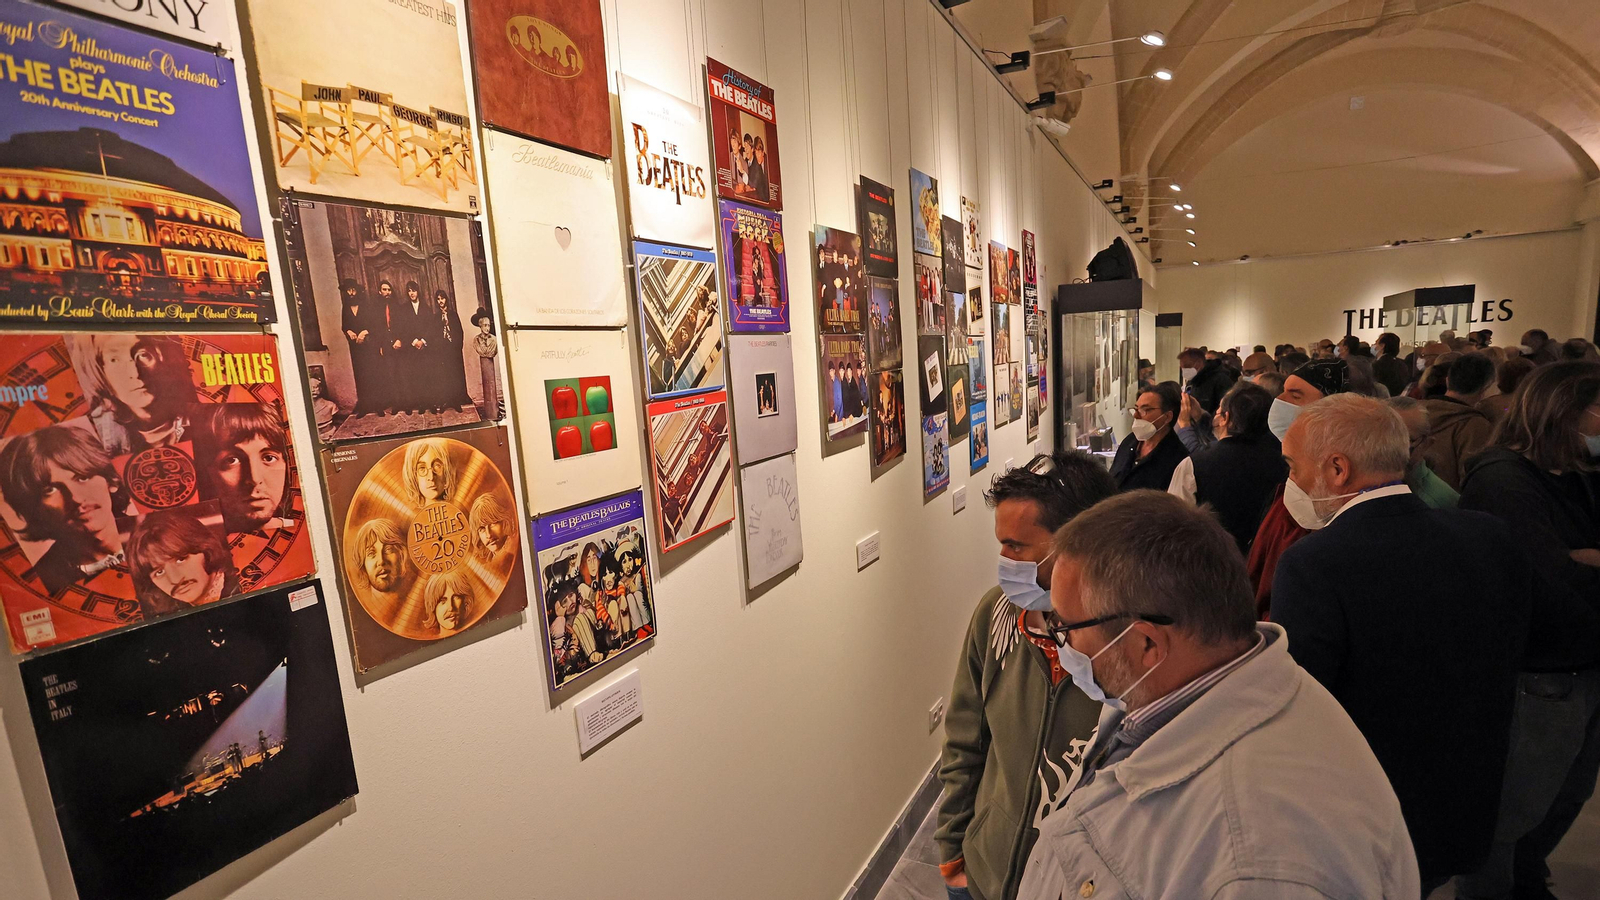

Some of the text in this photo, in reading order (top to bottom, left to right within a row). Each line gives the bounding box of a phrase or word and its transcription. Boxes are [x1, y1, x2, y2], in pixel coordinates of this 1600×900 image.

[38, 20, 152, 72] Philharmonic
[149, 49, 219, 88] Orchestra
[69, 57, 106, 74] plays
[0, 52, 176, 115] THE BEATLES
[313, 87, 342, 102] JOHN
[722, 69, 762, 99] History of
[20, 90, 159, 128] 20th Anniversary Concert
[358, 89, 383, 105] PAUL
[711, 79, 773, 121] THE BEATLES
[392, 104, 433, 129] GEORGE
[437, 109, 464, 126] RINGO
[662, 140, 678, 157] THE
[511, 144, 594, 180] Beatlemania
[631, 122, 706, 206] BEATLES
[37, 304, 49, 321] by
[49, 296, 94, 318] Louis
[92, 297, 135, 320] Clark
[136, 307, 153, 318] with
[154, 307, 166, 318] the
[164, 303, 197, 322] Royal
[197, 303, 228, 320] Choral
[228, 304, 257, 322] Society
[1343, 308, 1388, 337] THE
[540, 350, 566, 360] ARTFULLY
[200, 352, 275, 387] BEATLES
[426, 504, 448, 522] THE
[550, 500, 631, 533] THE BEATLES BALLADS
[414, 512, 465, 542] BEATLES
[431, 539, 455, 561] 20
[445, 556, 458, 571] DE
[457, 534, 468, 558] ORO
[26, 612, 46, 622] EMI
[42, 674, 58, 686] THE
[45, 680, 78, 698] BEATLES
[48, 698, 57, 710] IN
[51, 705, 72, 721] ITALY
